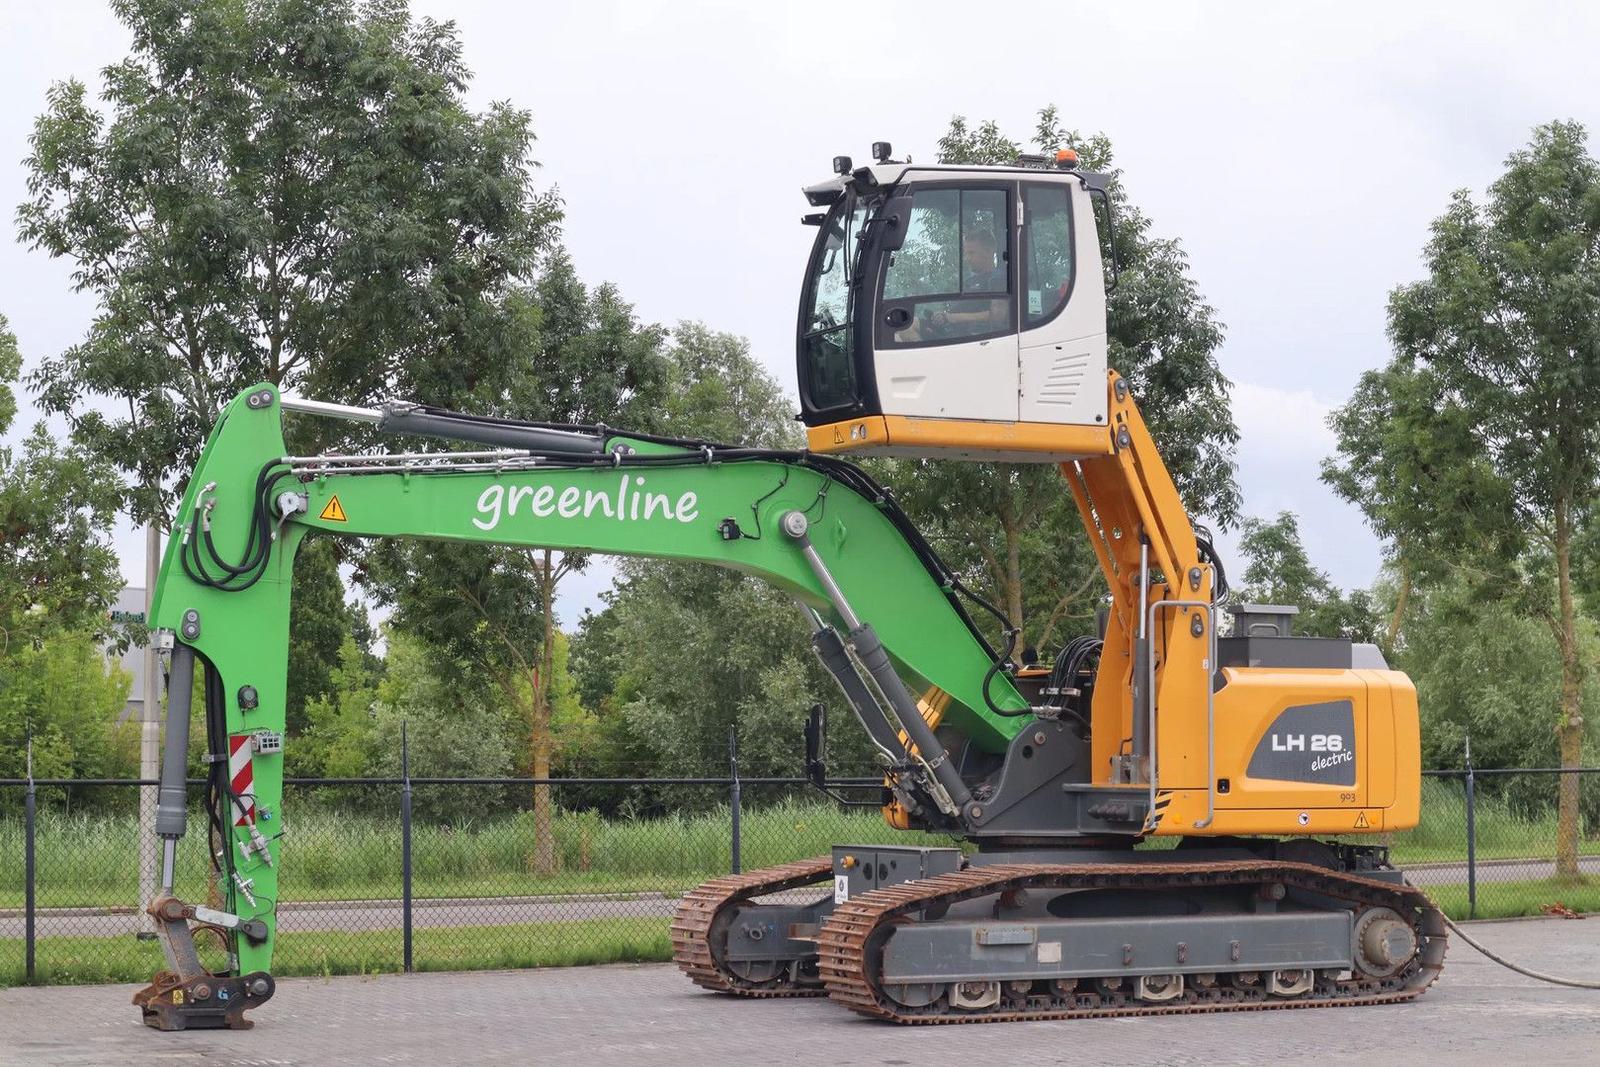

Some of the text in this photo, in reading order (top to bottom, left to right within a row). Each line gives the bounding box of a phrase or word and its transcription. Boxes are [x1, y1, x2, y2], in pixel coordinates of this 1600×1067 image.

[472, 474, 699, 531] greenline
[1271, 734, 1343, 752] LH 26
[1311, 748, 1353, 771] electric
